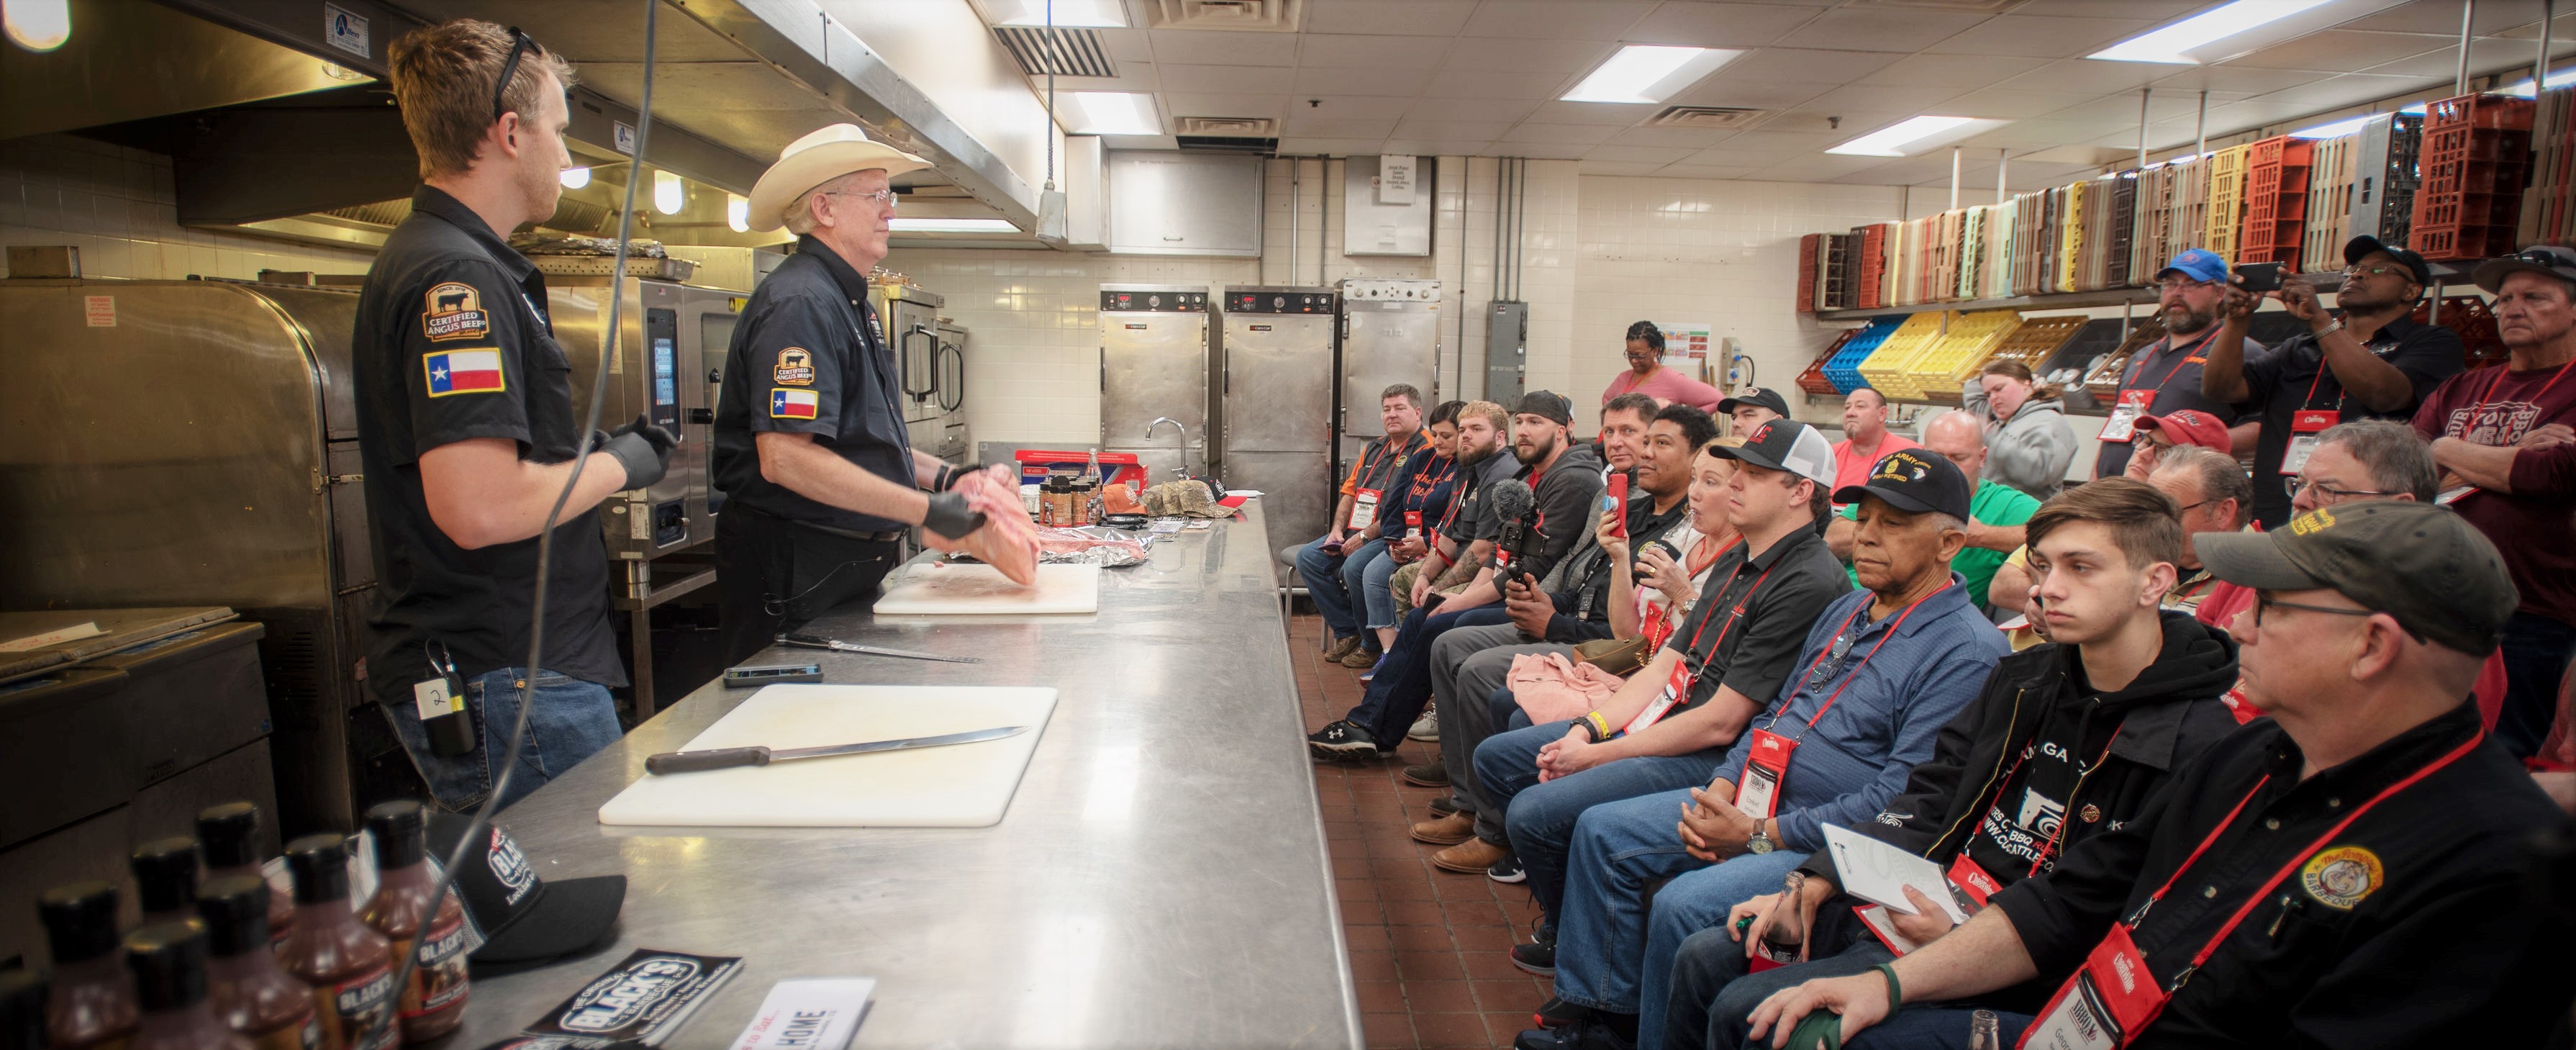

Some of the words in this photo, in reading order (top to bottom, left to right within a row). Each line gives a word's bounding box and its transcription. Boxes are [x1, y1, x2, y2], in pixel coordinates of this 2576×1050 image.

[429, 312, 478, 327] CERTIFIED
[427, 322, 460, 335] ANGUS
[1895, 453, 1918, 464] ARMY
[430, 689, 446, 706] 2
[2009, 831, 2033, 846] BBQ
[2306, 873, 2362, 907] BARBEQUE
[568, 961, 681, 1029] BLACK'S
[627, 977, 676, 1016] BARBECUE
[775, 1010, 827, 1046] HOME
